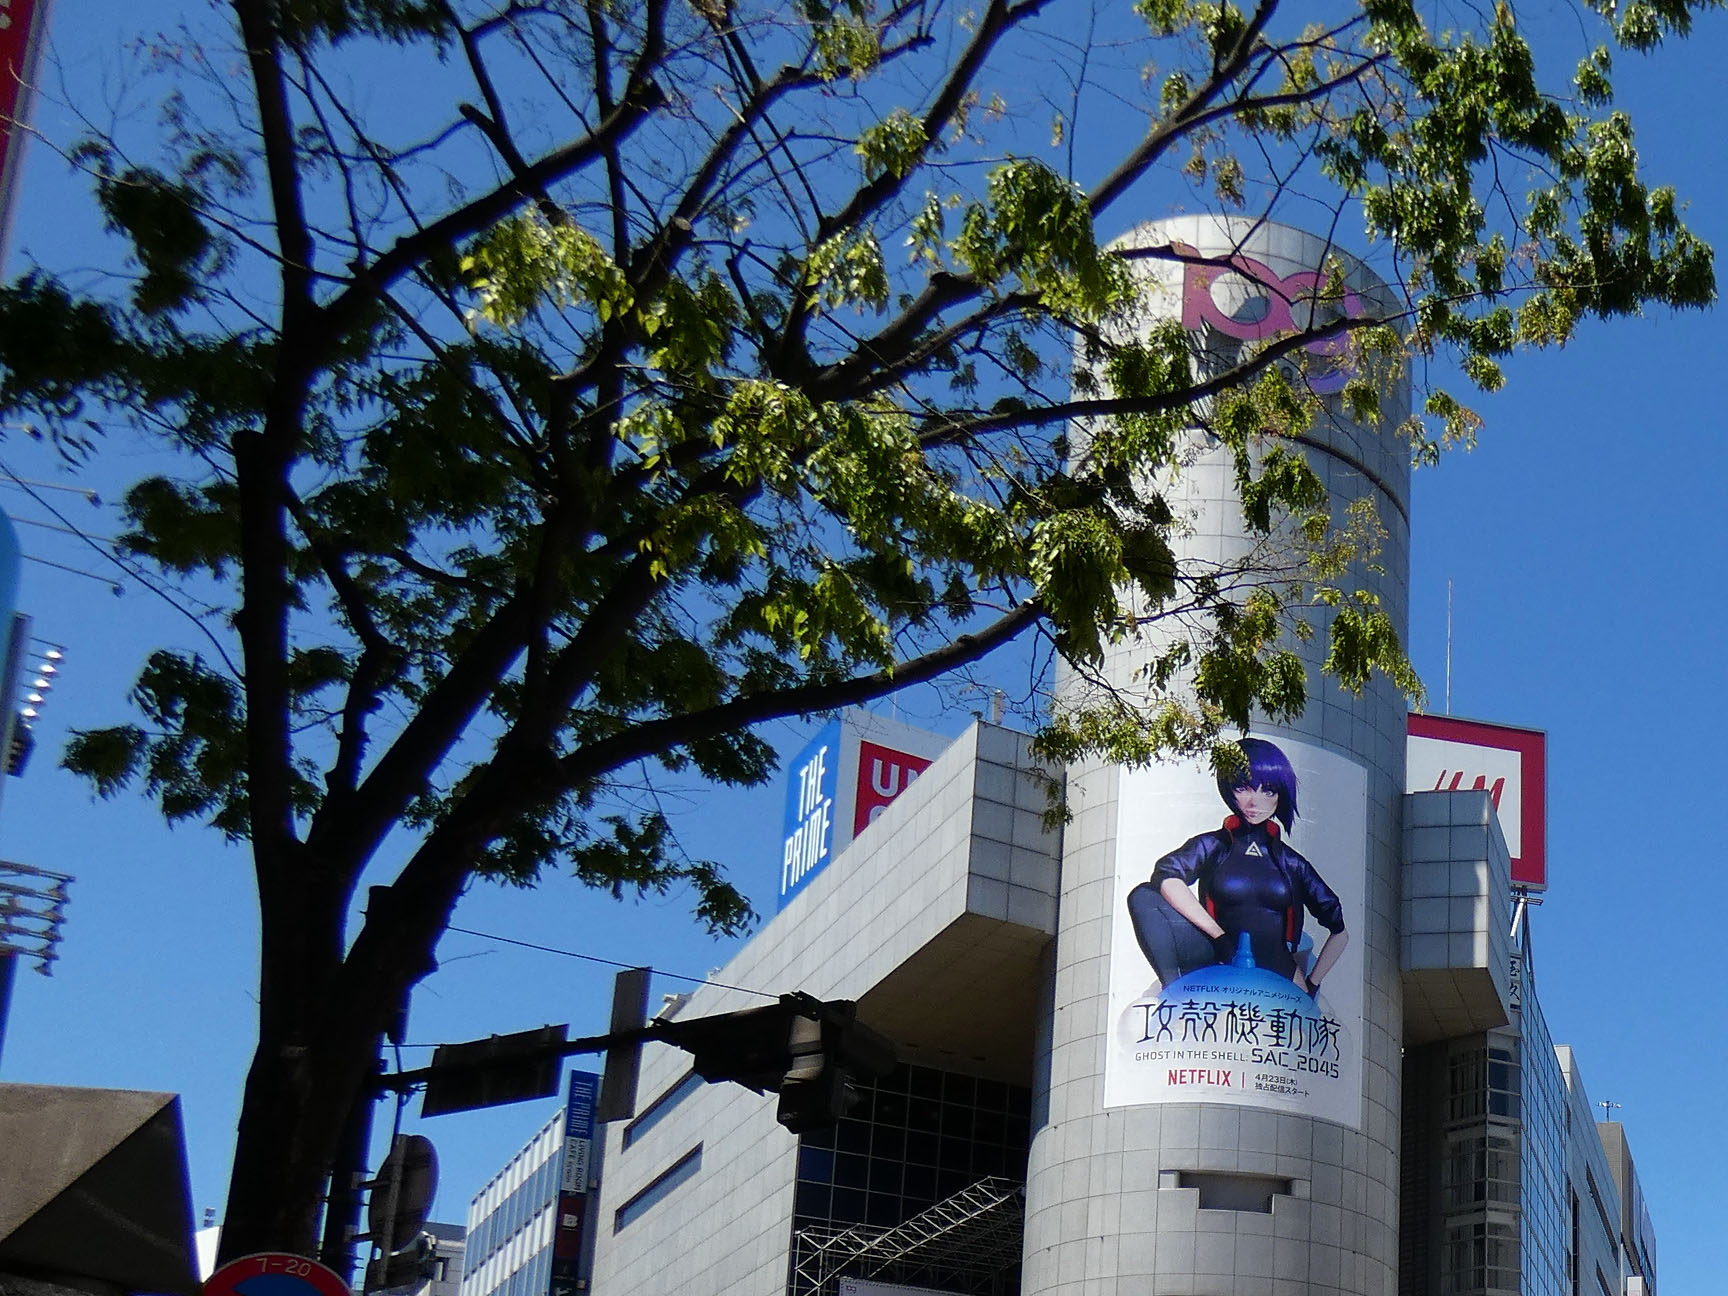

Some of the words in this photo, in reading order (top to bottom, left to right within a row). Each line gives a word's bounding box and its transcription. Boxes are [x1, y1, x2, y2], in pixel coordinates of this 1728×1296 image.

[797, 744, 828, 823] THE
[781, 797, 833, 896] PRIME
[1182, 984, 1220, 993] NETFLIX
[1132, 998, 1341, 1062] 攻殻機動隊
[1135, 1051, 1170, 1062] GHOST
[1172, 1051, 1184, 1060] IN
[1187, 1050, 1209, 1061] THE
[1250, 1047, 1340, 1079] SAC_2045
[1167, 1069, 1232, 1088] NETFLIX
[1254, 1073, 1299, 1086] 4月23日(木)
[575, 1081, 593, 1101] THE
[1254, 1082, 1311, 1098] 独占配信スタート
[570, 1101, 591, 1136] PRIME
[255, 1256, 312, 1277] 7-20
